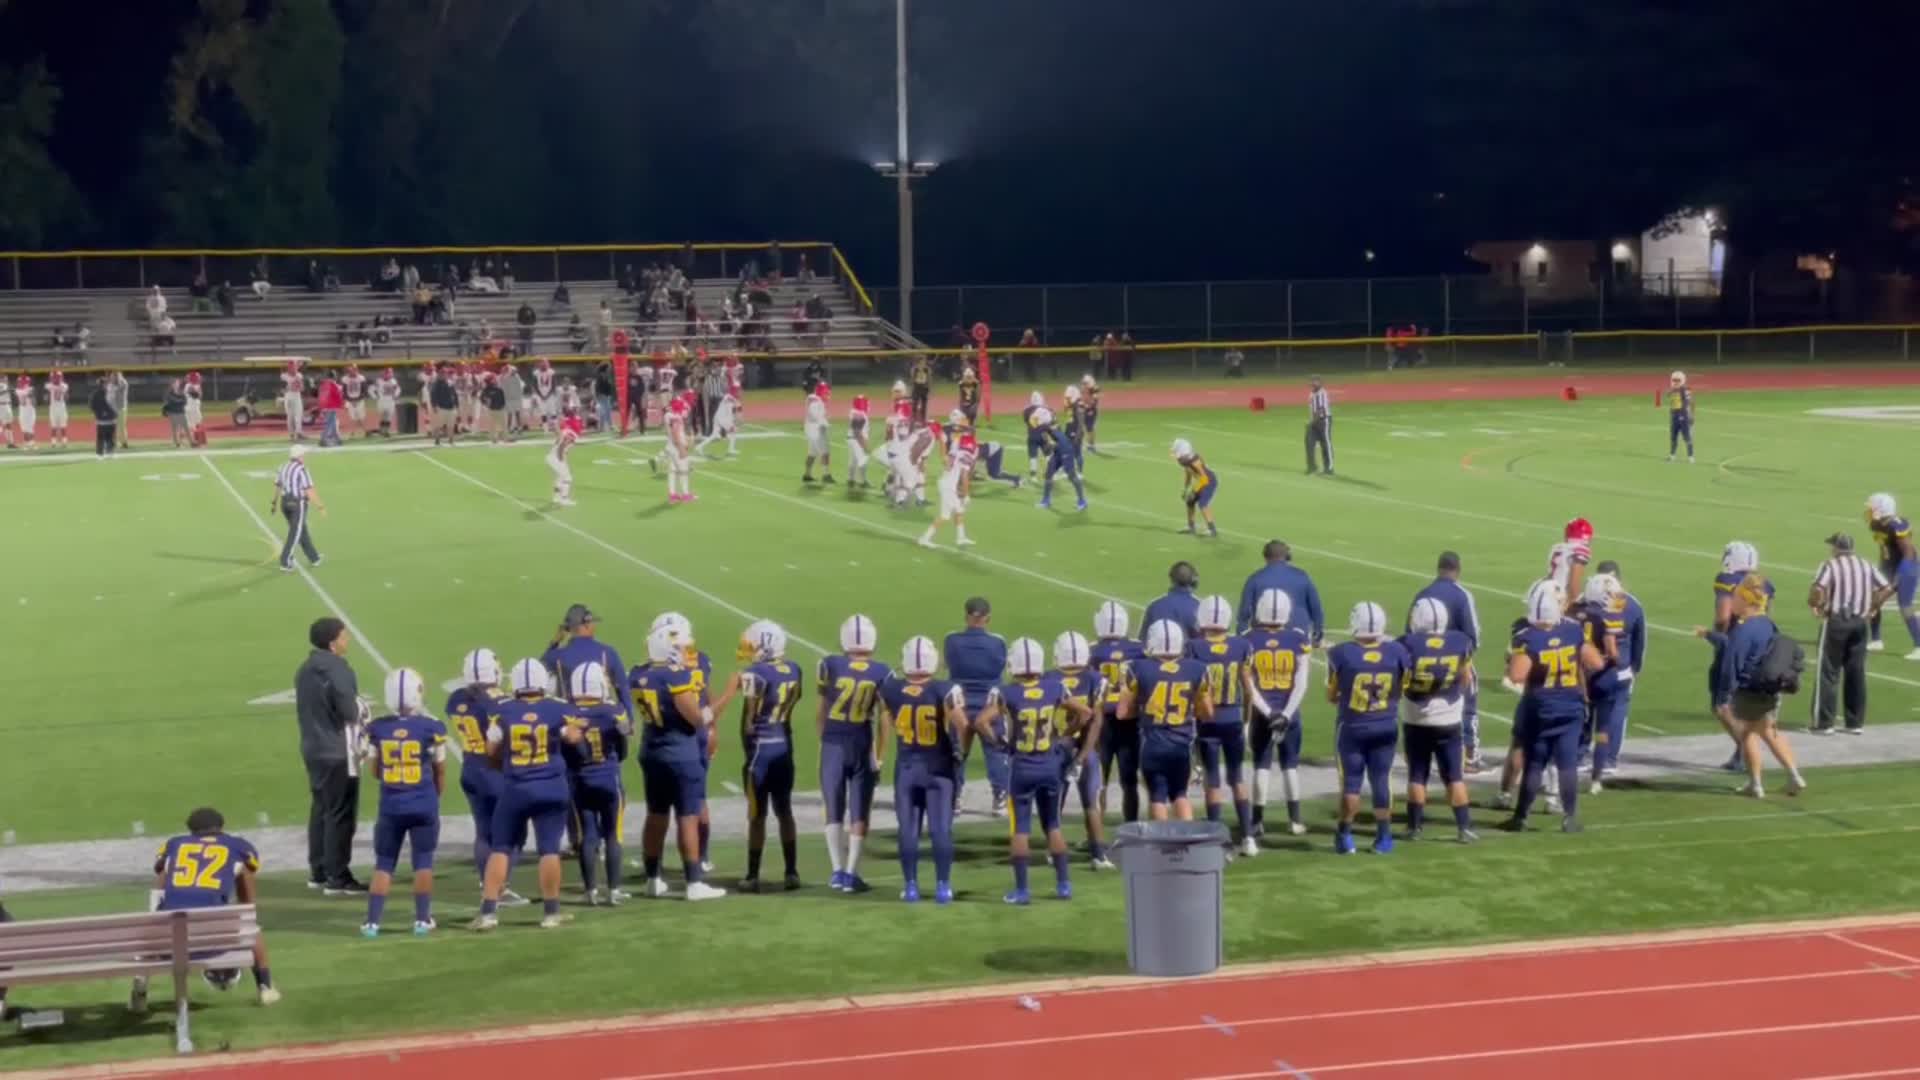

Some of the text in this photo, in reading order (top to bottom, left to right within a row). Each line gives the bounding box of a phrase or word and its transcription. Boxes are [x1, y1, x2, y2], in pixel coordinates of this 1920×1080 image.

[1415, 655, 1459, 693] 57
[1539, 645, 1579, 689] 75
[828, 675, 877, 723] 20
[1145, 681, 1191, 725] 45
[1349, 671, 1392, 712] 63
[510, 724, 550, 766] 51
[895, 704, 937, 746] 46
[1016, 704, 1055, 752] 33
[379, 740, 422, 784] 56
[172, 843, 230, 889] 52
